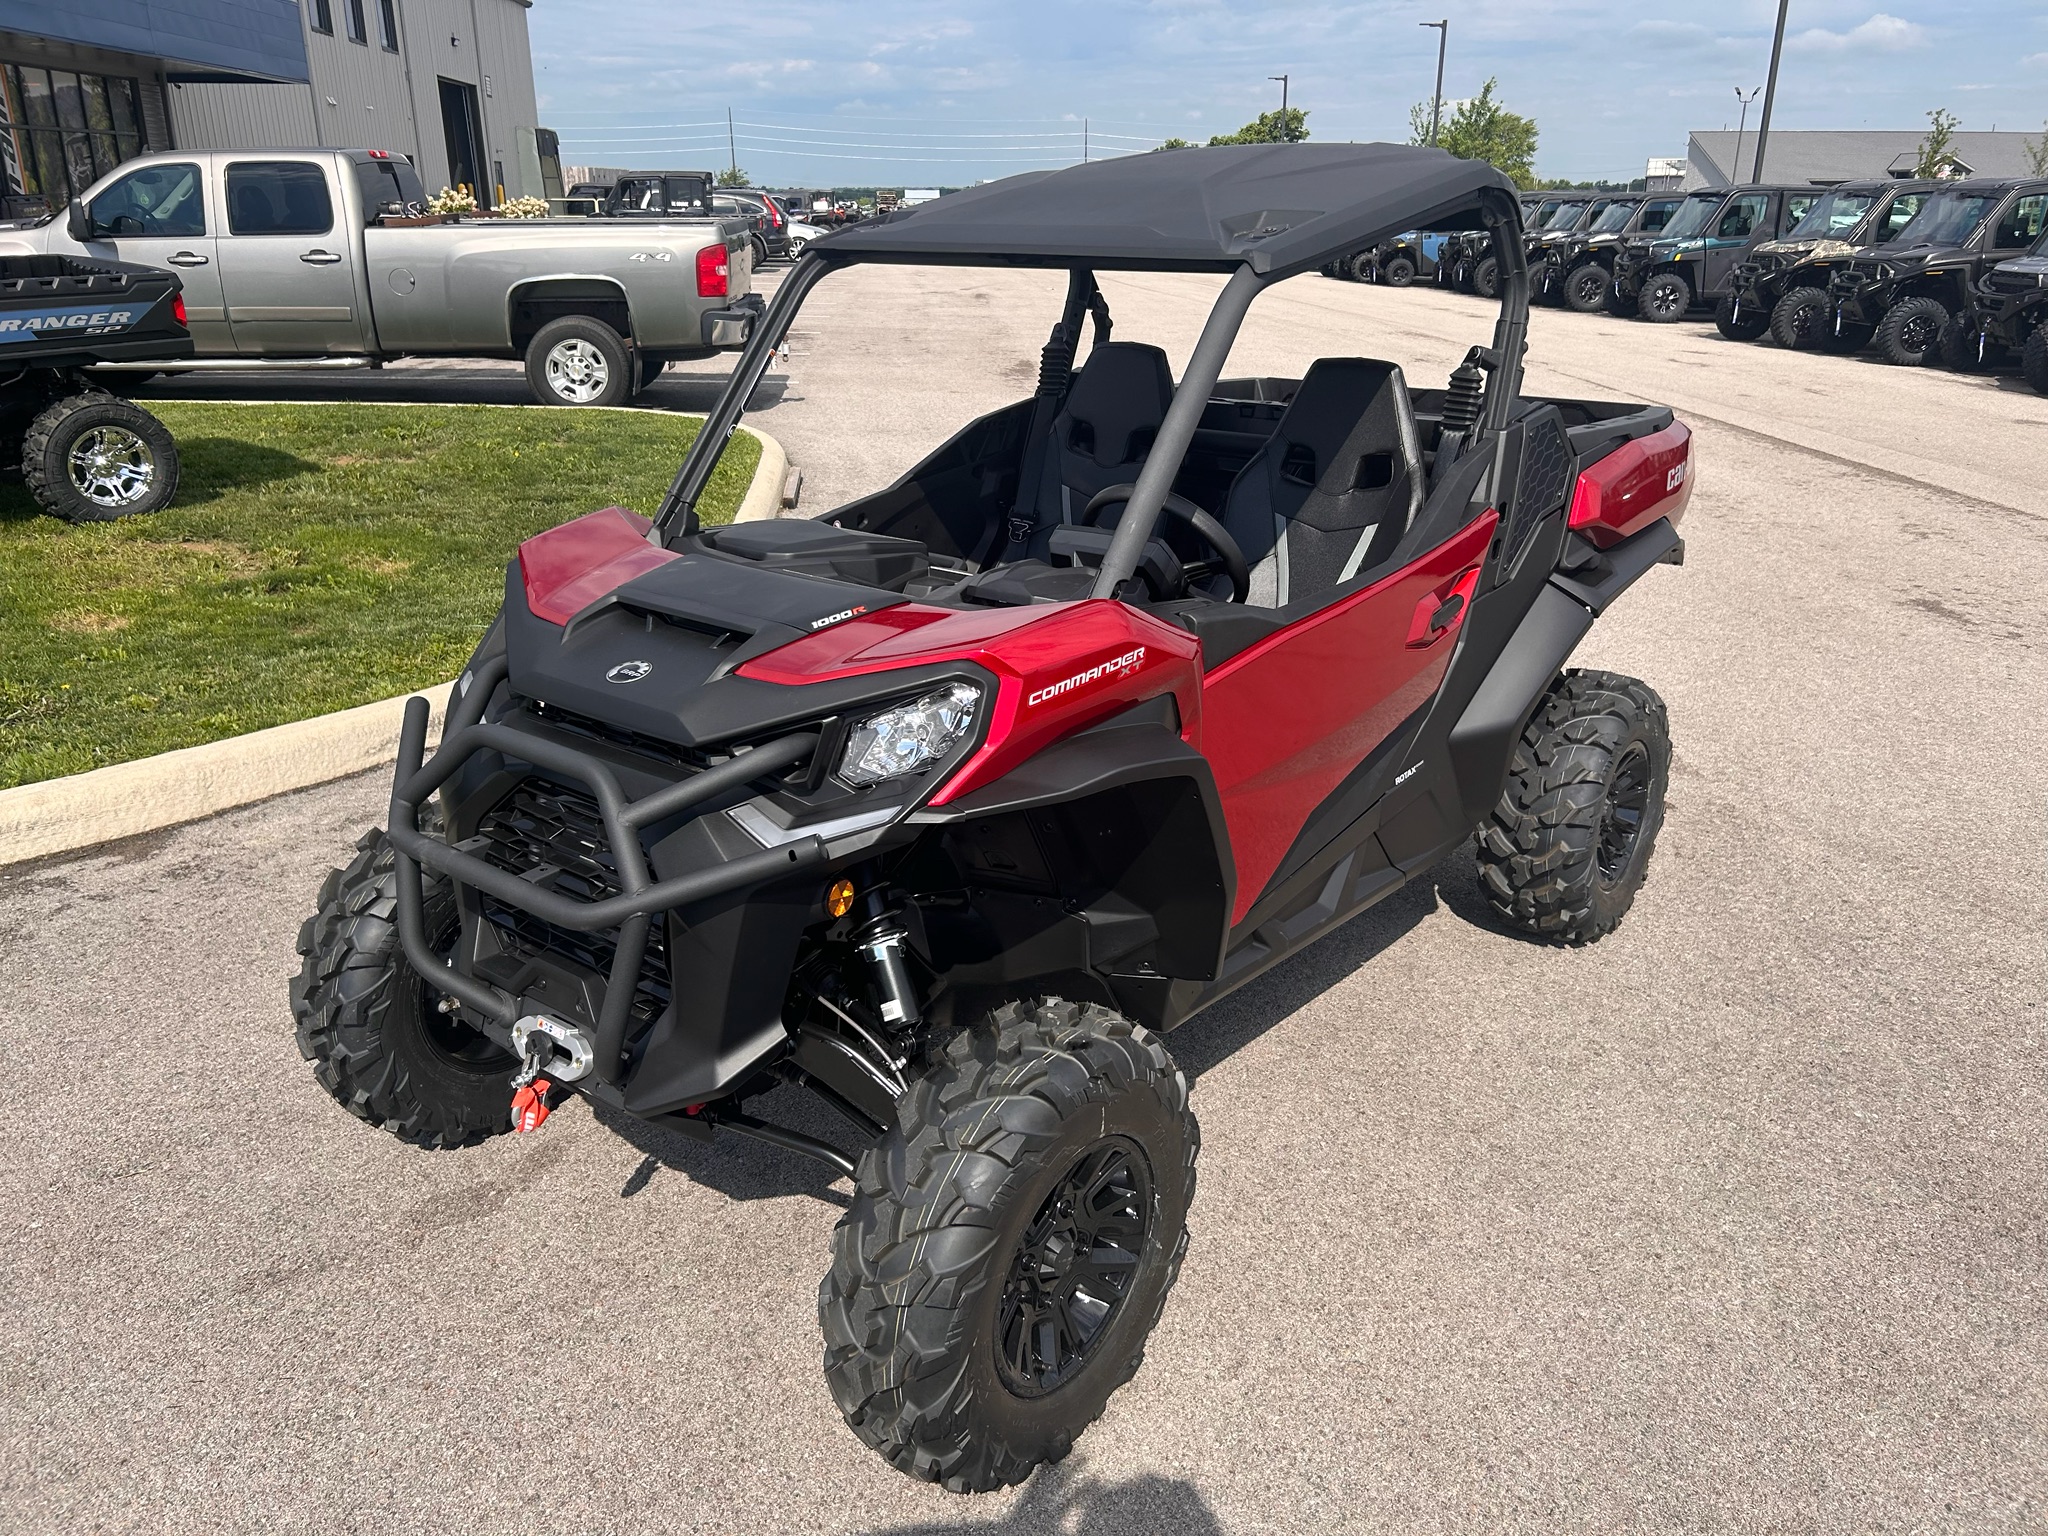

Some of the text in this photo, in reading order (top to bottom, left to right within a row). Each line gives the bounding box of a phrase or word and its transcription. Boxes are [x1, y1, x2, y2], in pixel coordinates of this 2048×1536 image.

[0, 311, 132, 332] RANGER
[84, 325, 122, 335] SP
[811, 605, 867, 629] 1000R
[1028, 646, 1146, 706] COMMANDER
[1118, 660, 1144, 678] XT
[1395, 767, 1417, 786] ROTAX
